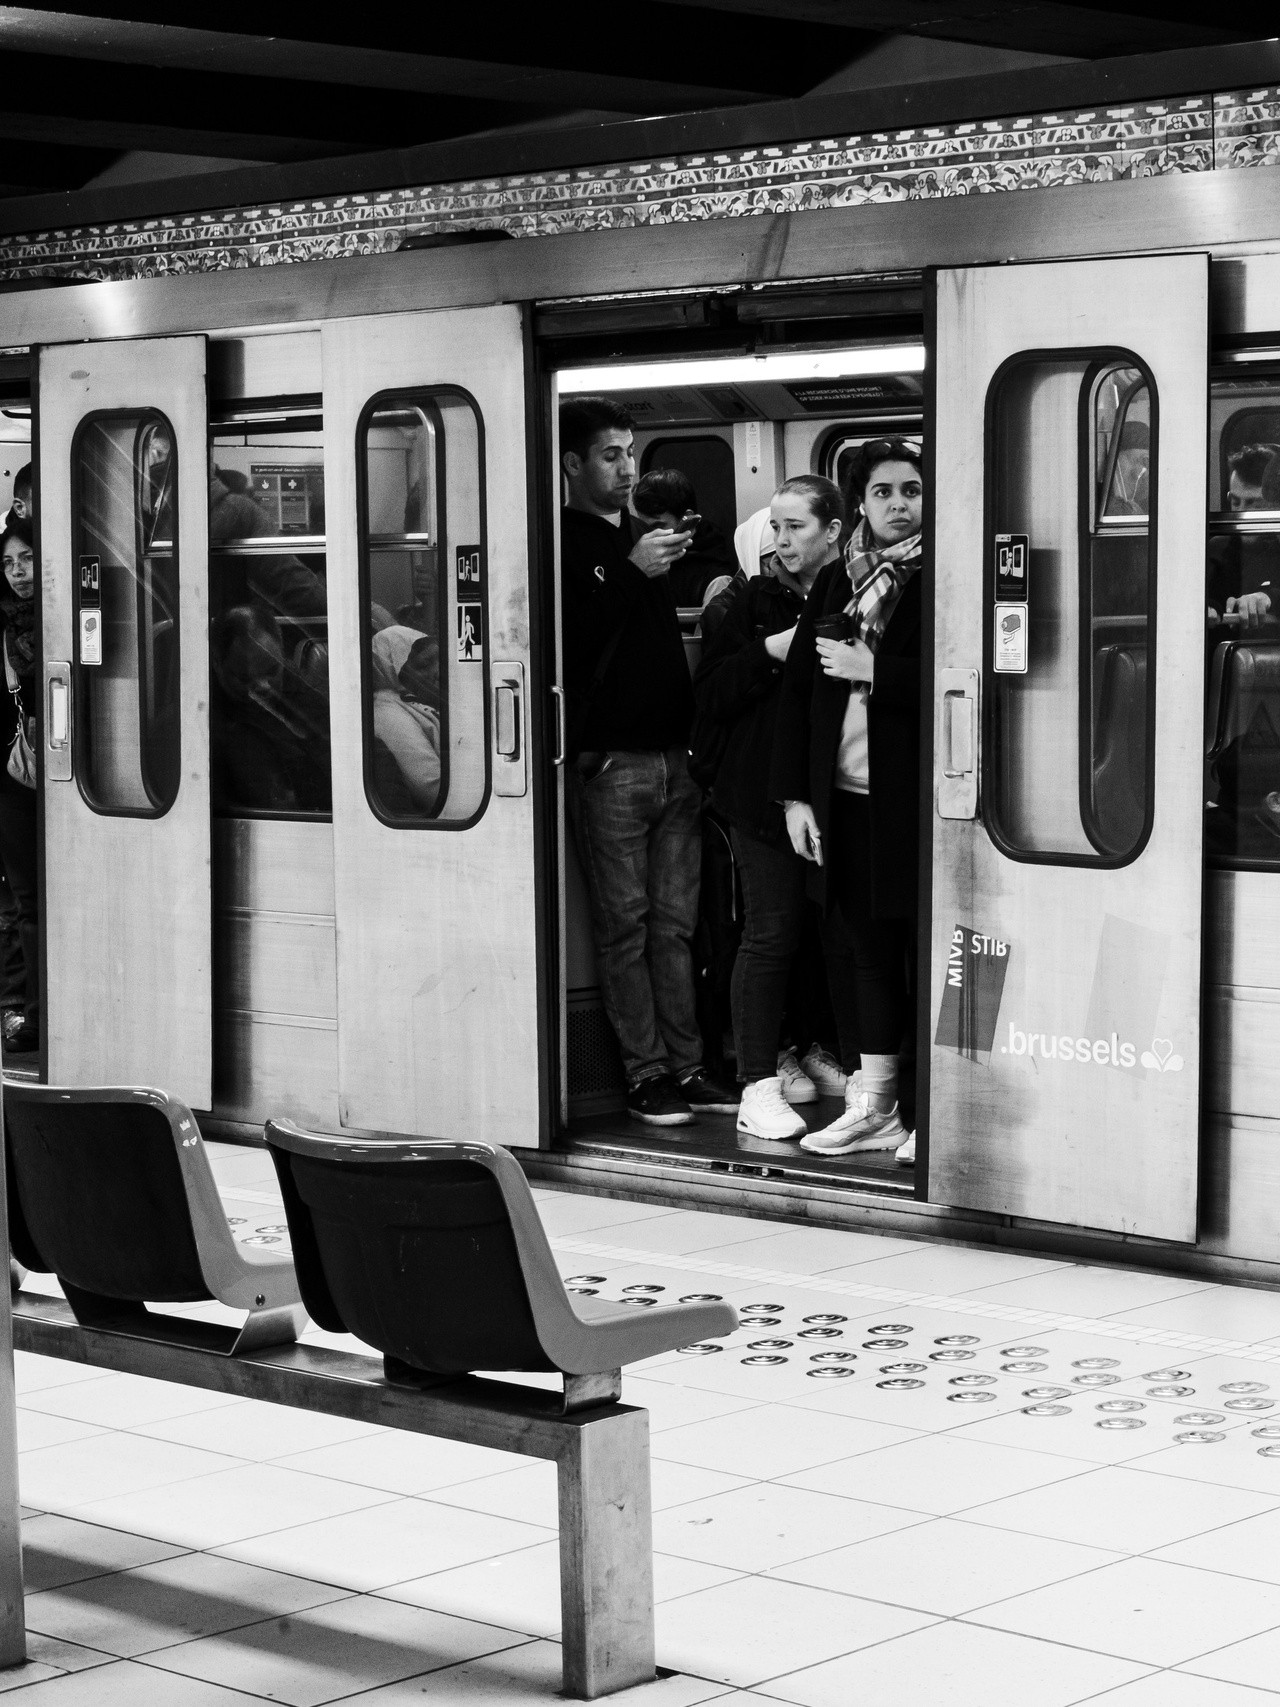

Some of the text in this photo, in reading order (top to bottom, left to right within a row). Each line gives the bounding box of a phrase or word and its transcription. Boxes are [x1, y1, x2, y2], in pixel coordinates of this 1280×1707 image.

[948, 929, 963, 987] MIVB
[971, 934, 1007, 957] STIB
[1001, 1021, 1137, 1067] .brussels
